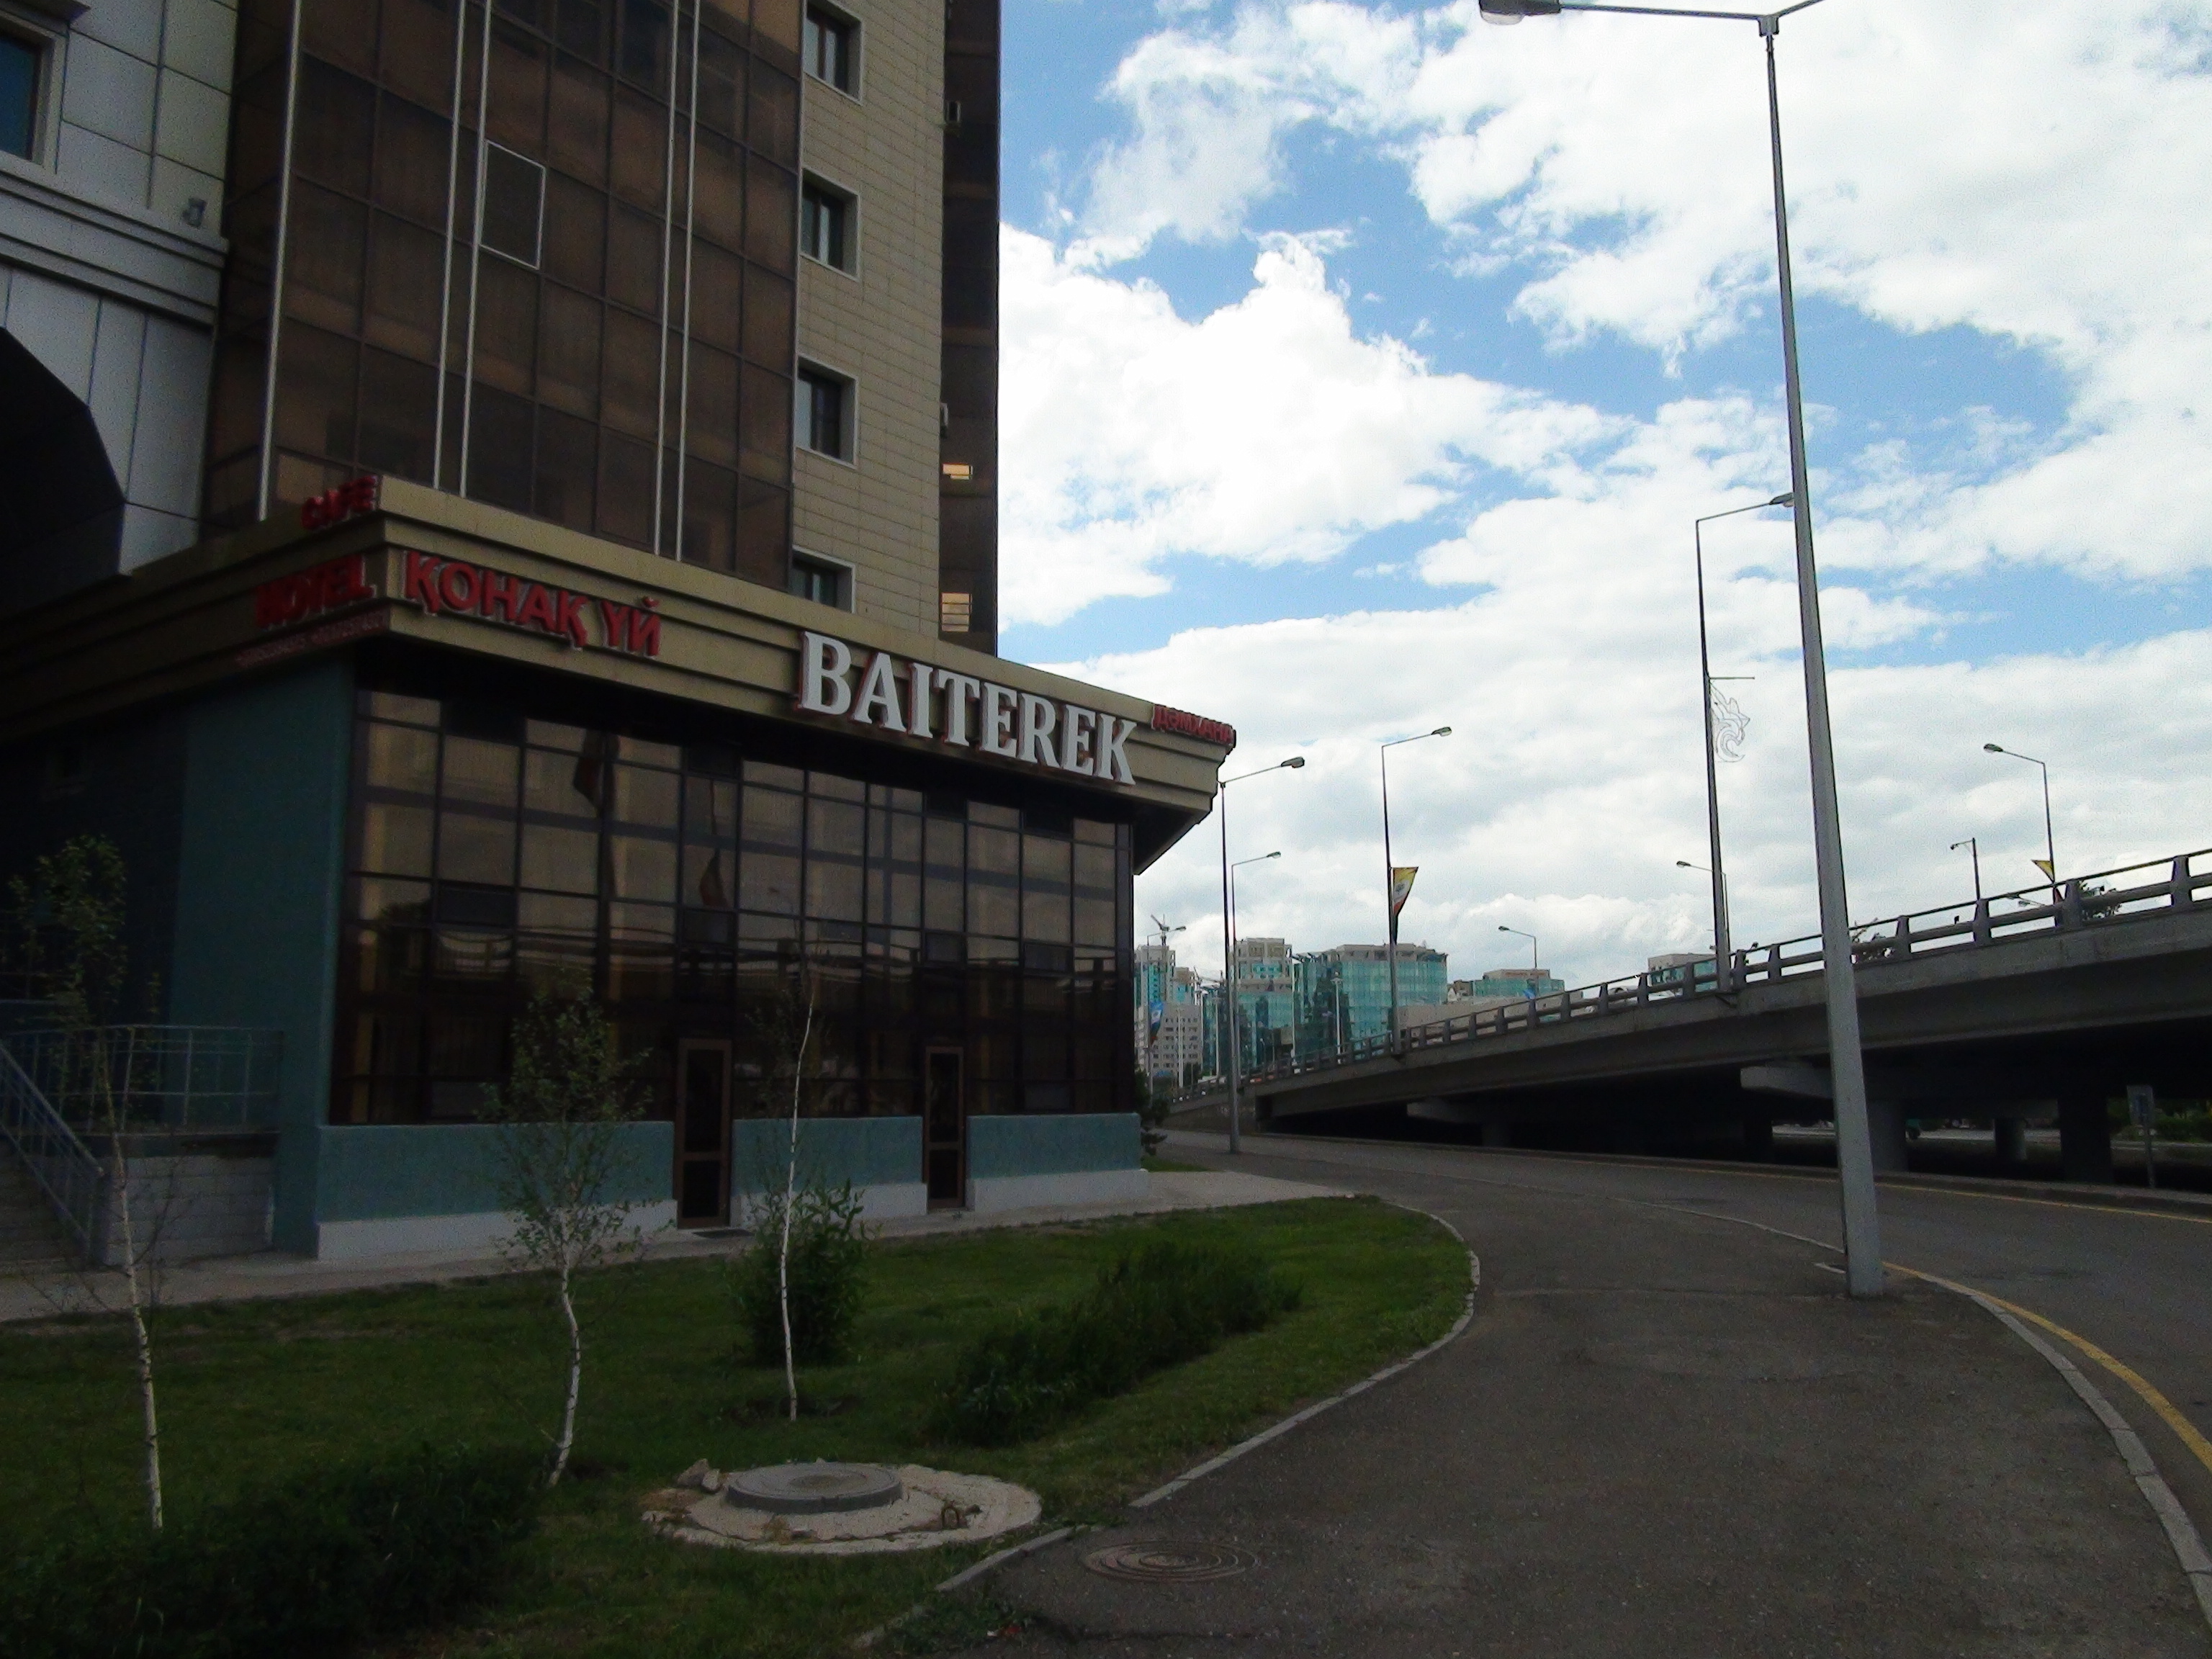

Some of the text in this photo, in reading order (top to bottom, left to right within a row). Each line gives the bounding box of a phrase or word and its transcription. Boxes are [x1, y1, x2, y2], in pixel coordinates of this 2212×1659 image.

[403, 550, 589, 651] ҚОНАҚ
[600, 595, 661, 657] ҮЙ
[795, 630, 1138, 786] BAITEREK
